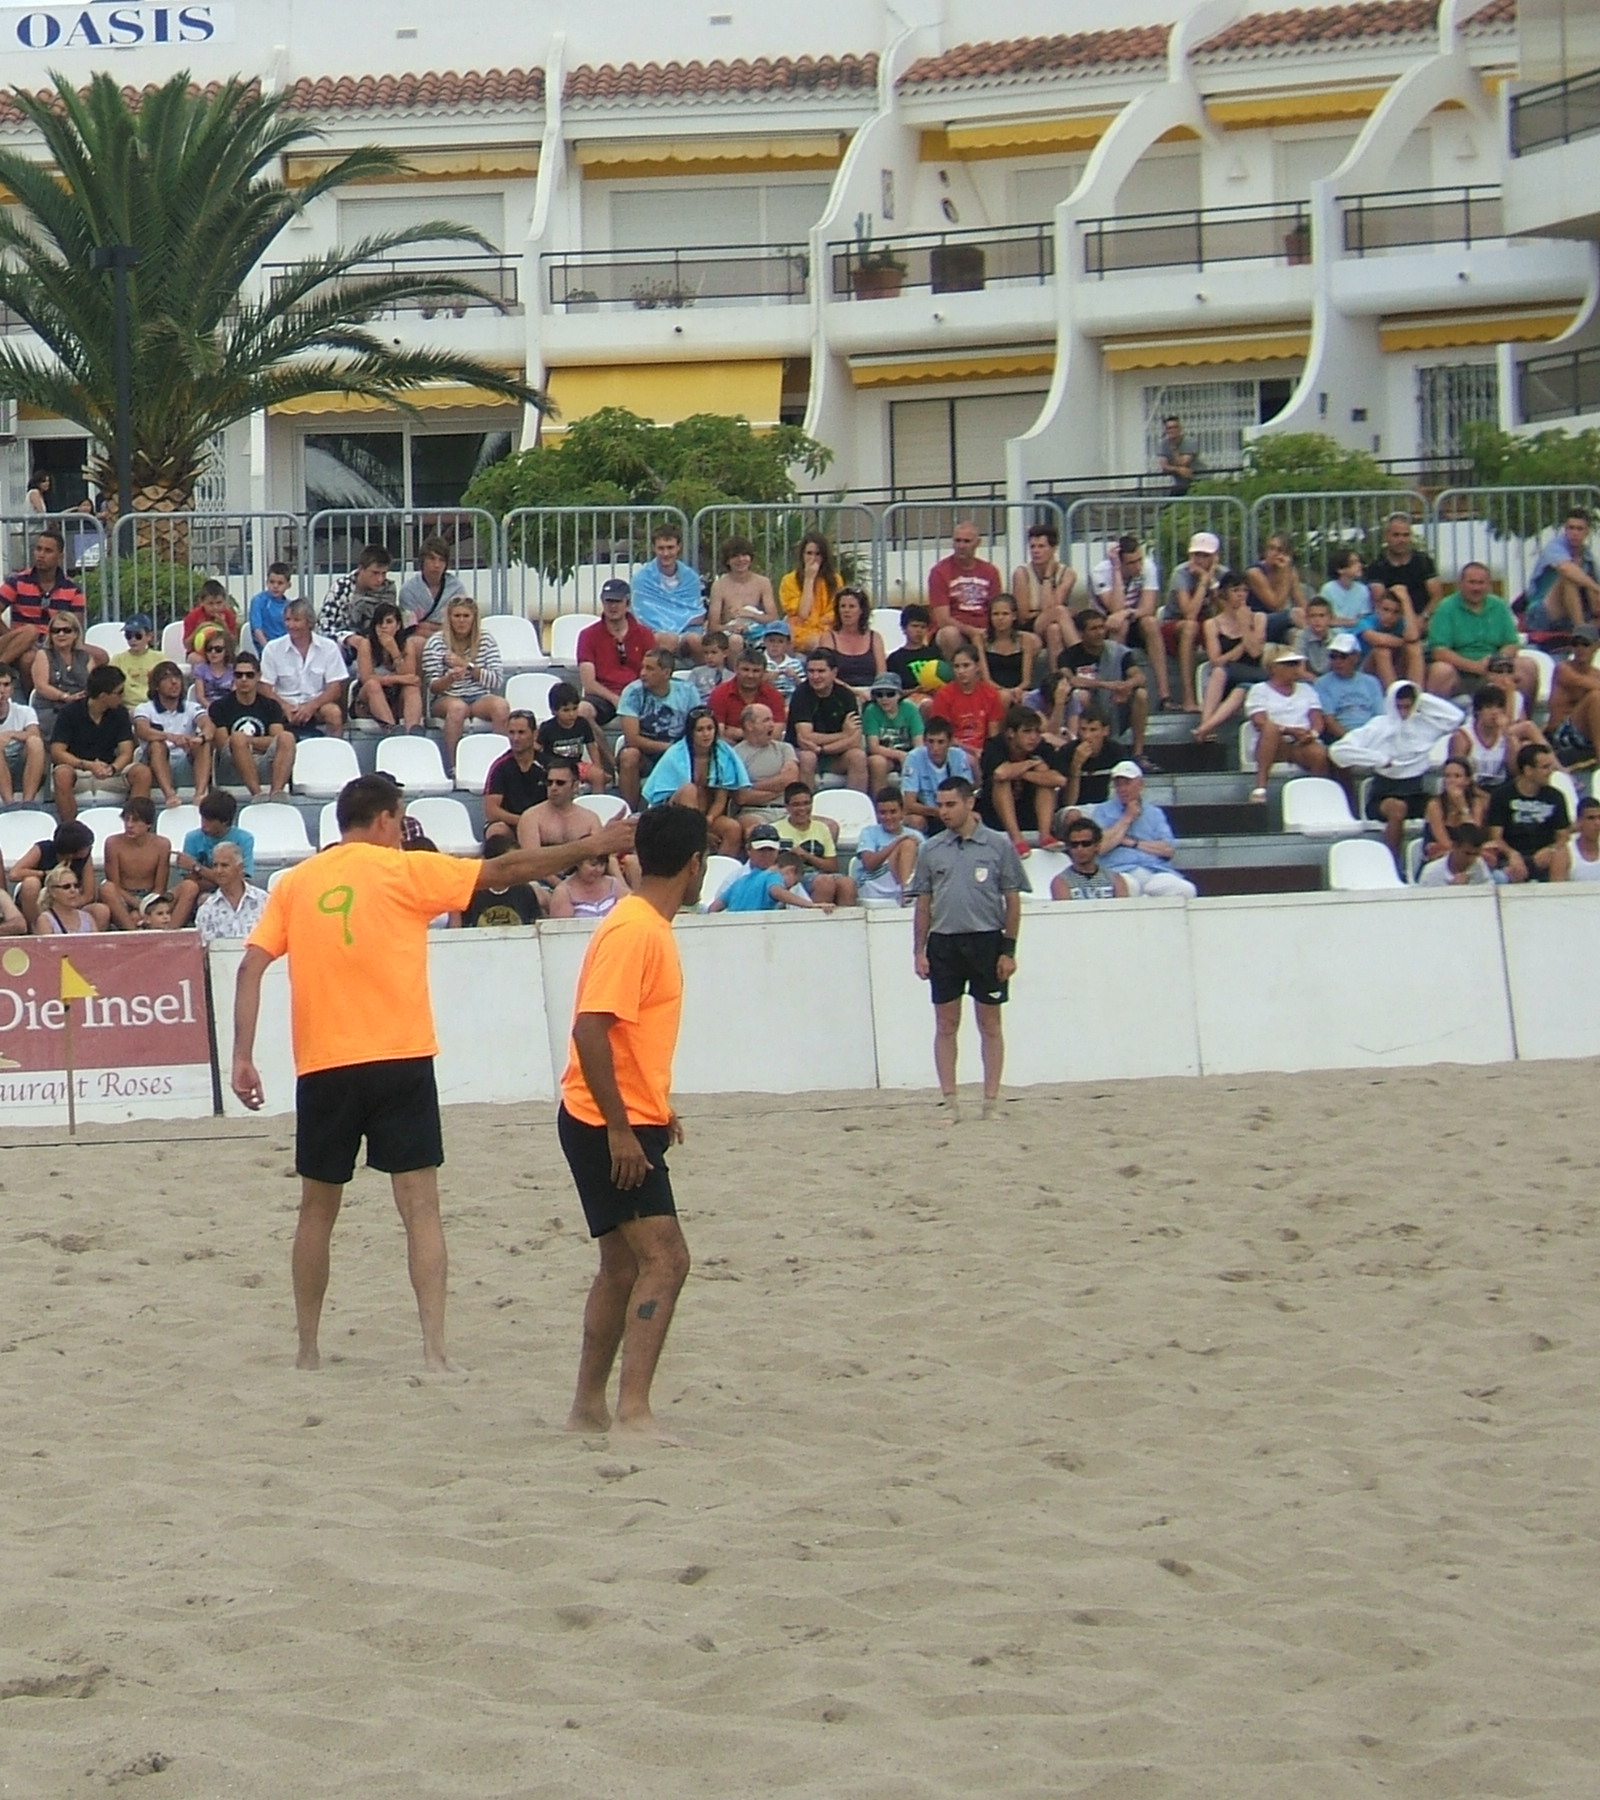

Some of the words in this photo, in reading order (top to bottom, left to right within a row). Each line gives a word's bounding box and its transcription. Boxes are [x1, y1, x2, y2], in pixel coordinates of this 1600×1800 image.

[16, 6, 215, 49] OASIS
[318, 885, 354, 946] 9
[81, 979, 197, 1028] Insel
[97, 1071, 173, 1098] Roses
